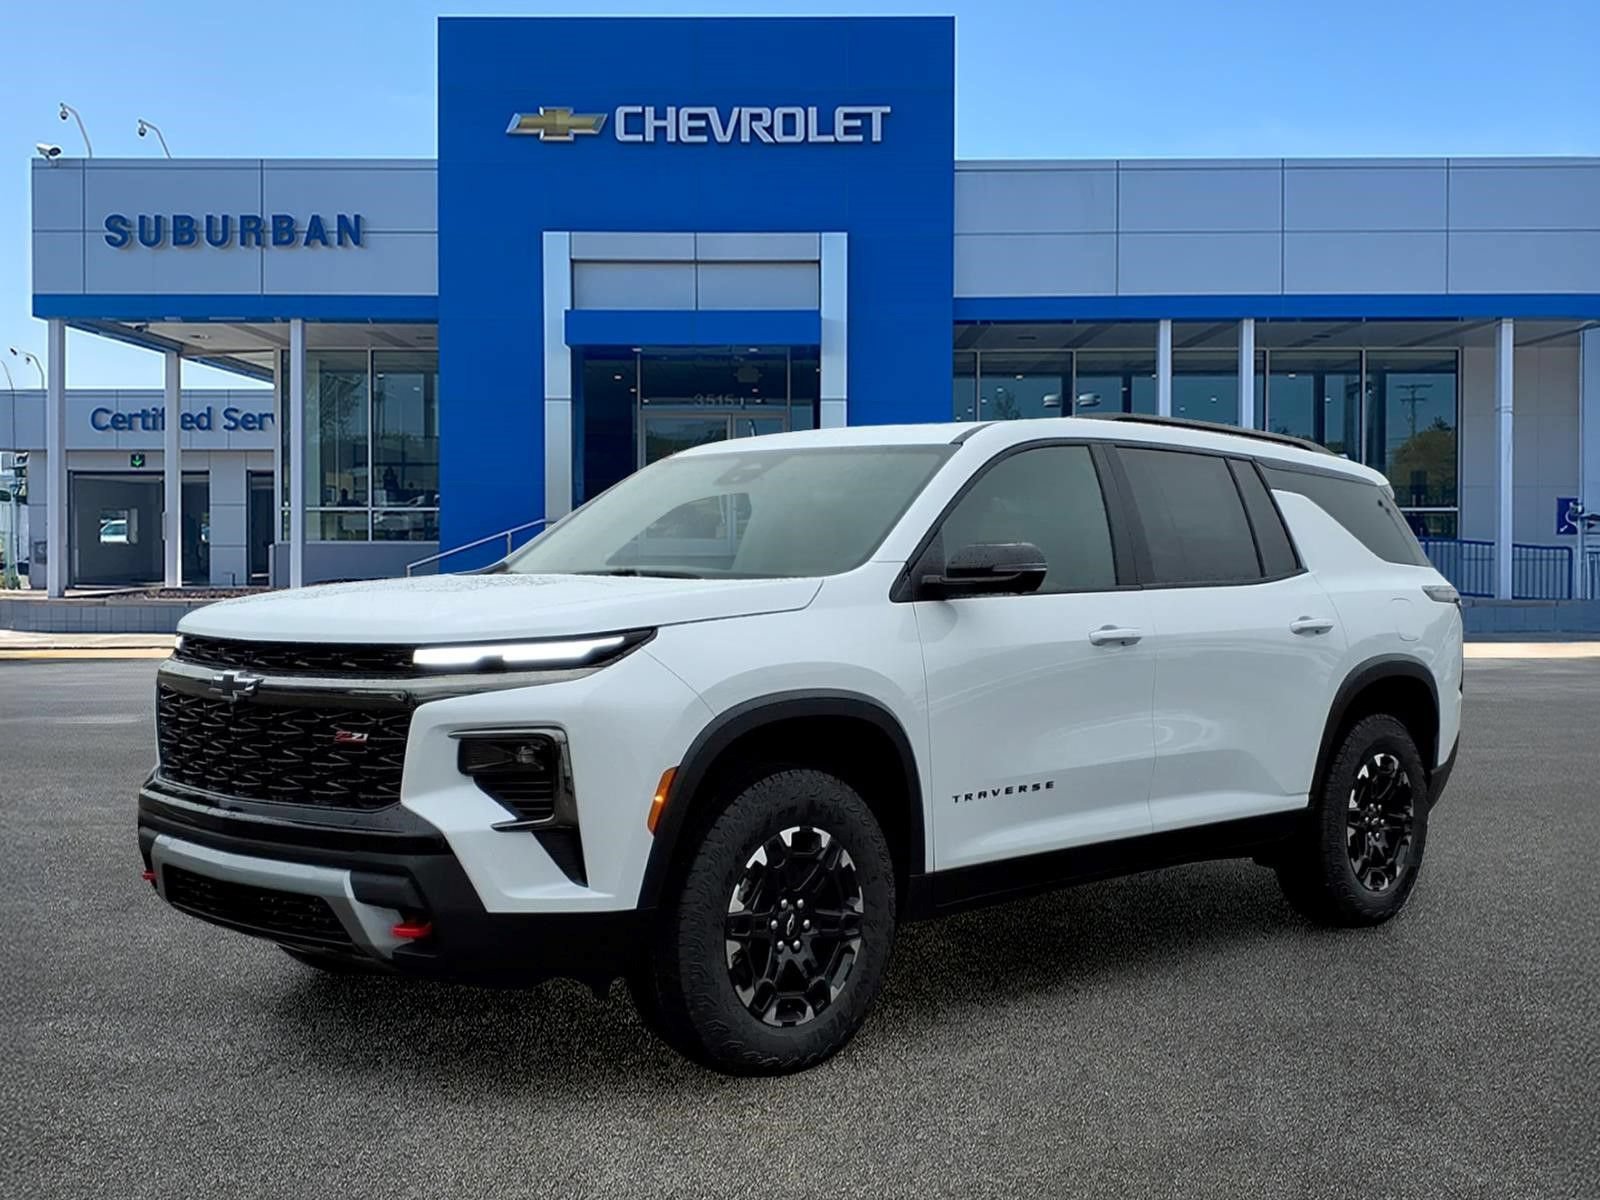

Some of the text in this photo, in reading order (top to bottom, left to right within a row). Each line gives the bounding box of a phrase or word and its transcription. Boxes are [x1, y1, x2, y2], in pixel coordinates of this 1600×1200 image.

[615, 105, 892, 143] CHEVROLET
[104, 213, 364, 249] SUBURBAN
[90, 406, 213, 432] Certifed
[952, 780, 1055, 804] TRAVERSE
